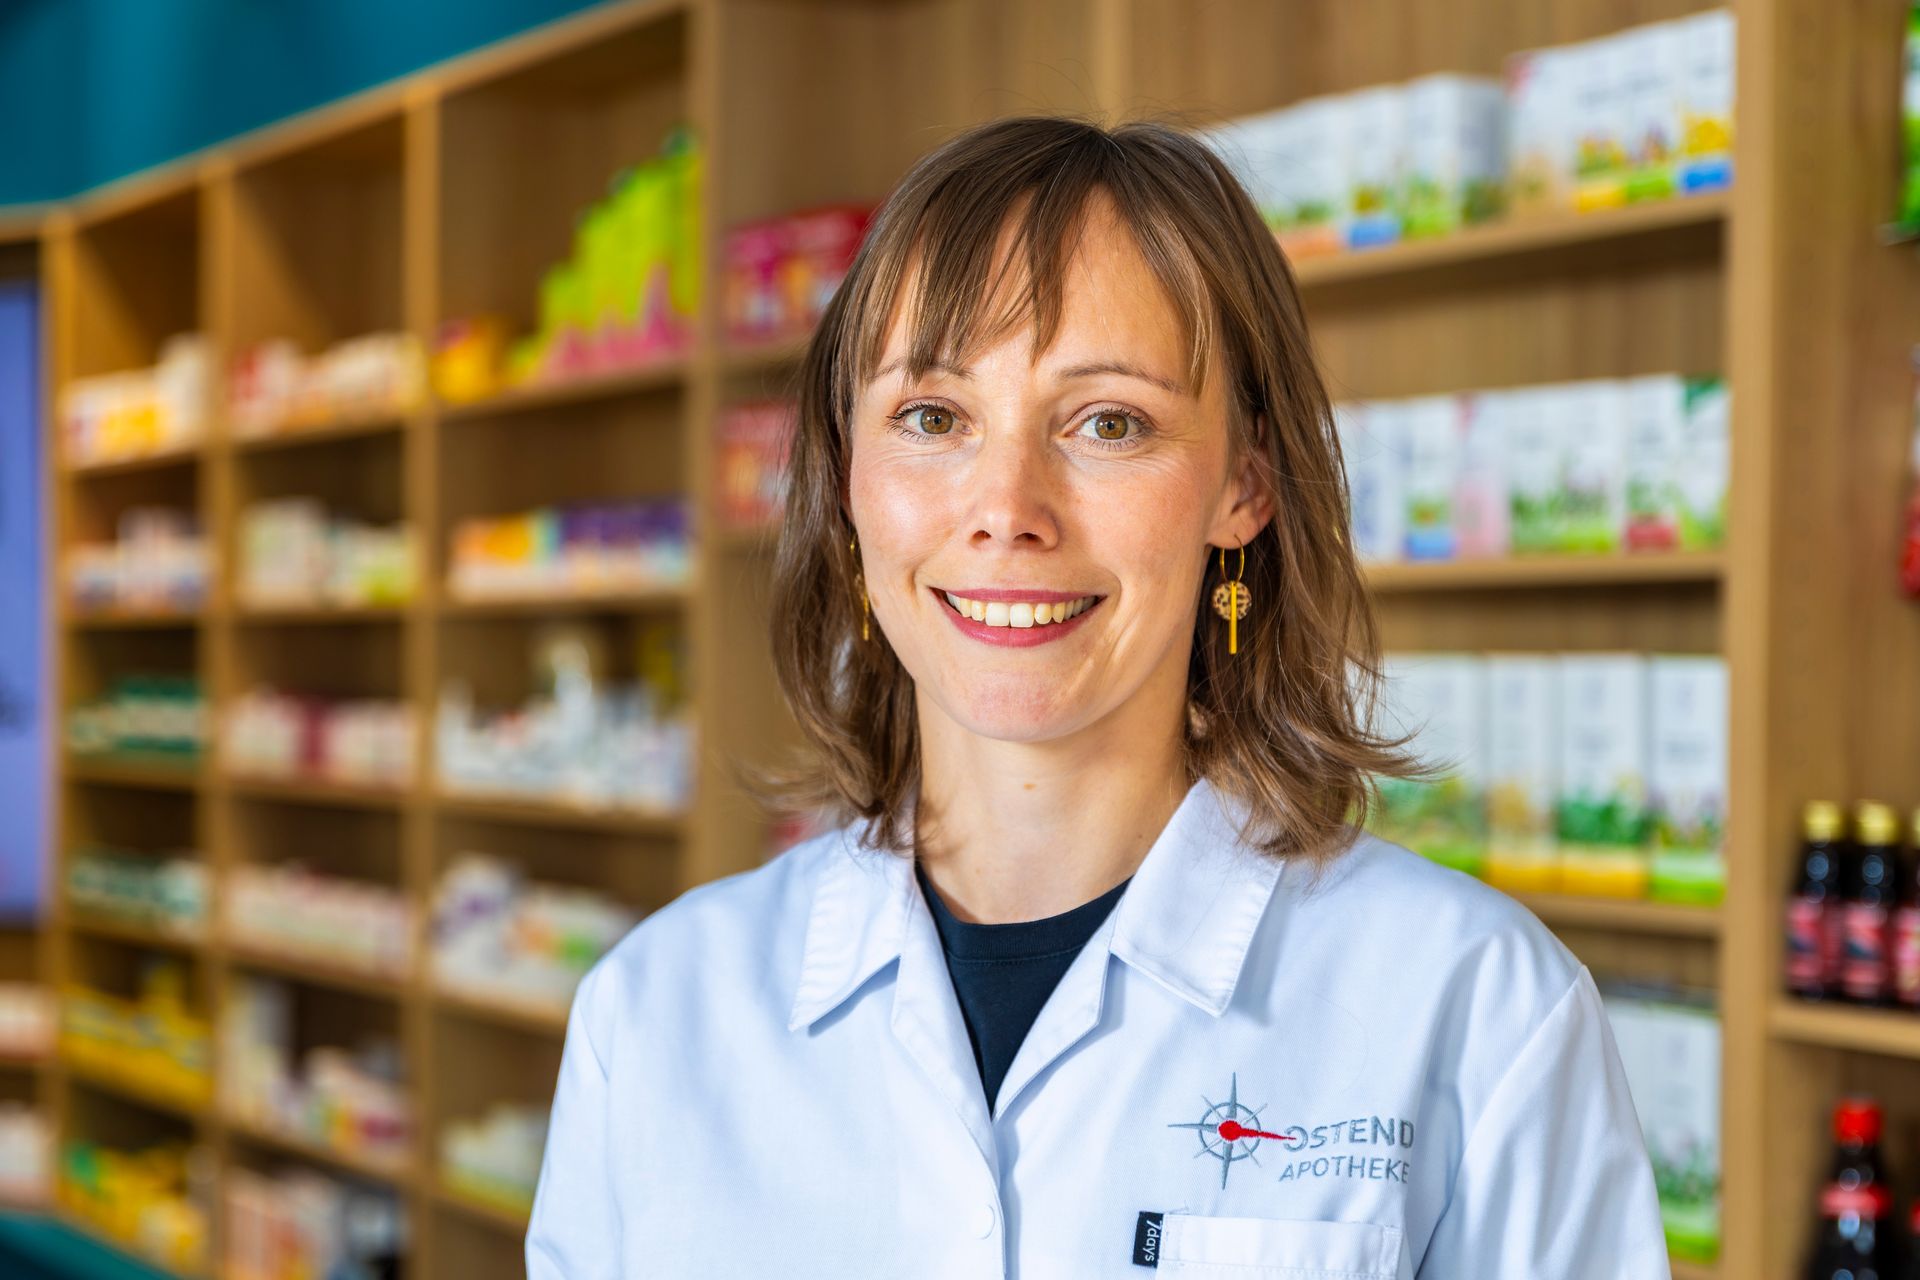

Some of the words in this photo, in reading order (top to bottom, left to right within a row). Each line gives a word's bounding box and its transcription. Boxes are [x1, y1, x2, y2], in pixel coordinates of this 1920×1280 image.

[1283, 1116, 1414, 1151] OSTEND
[1279, 1156, 1410, 1184] APOTHEKE
[1142, 1219, 1163, 1262] 7days
